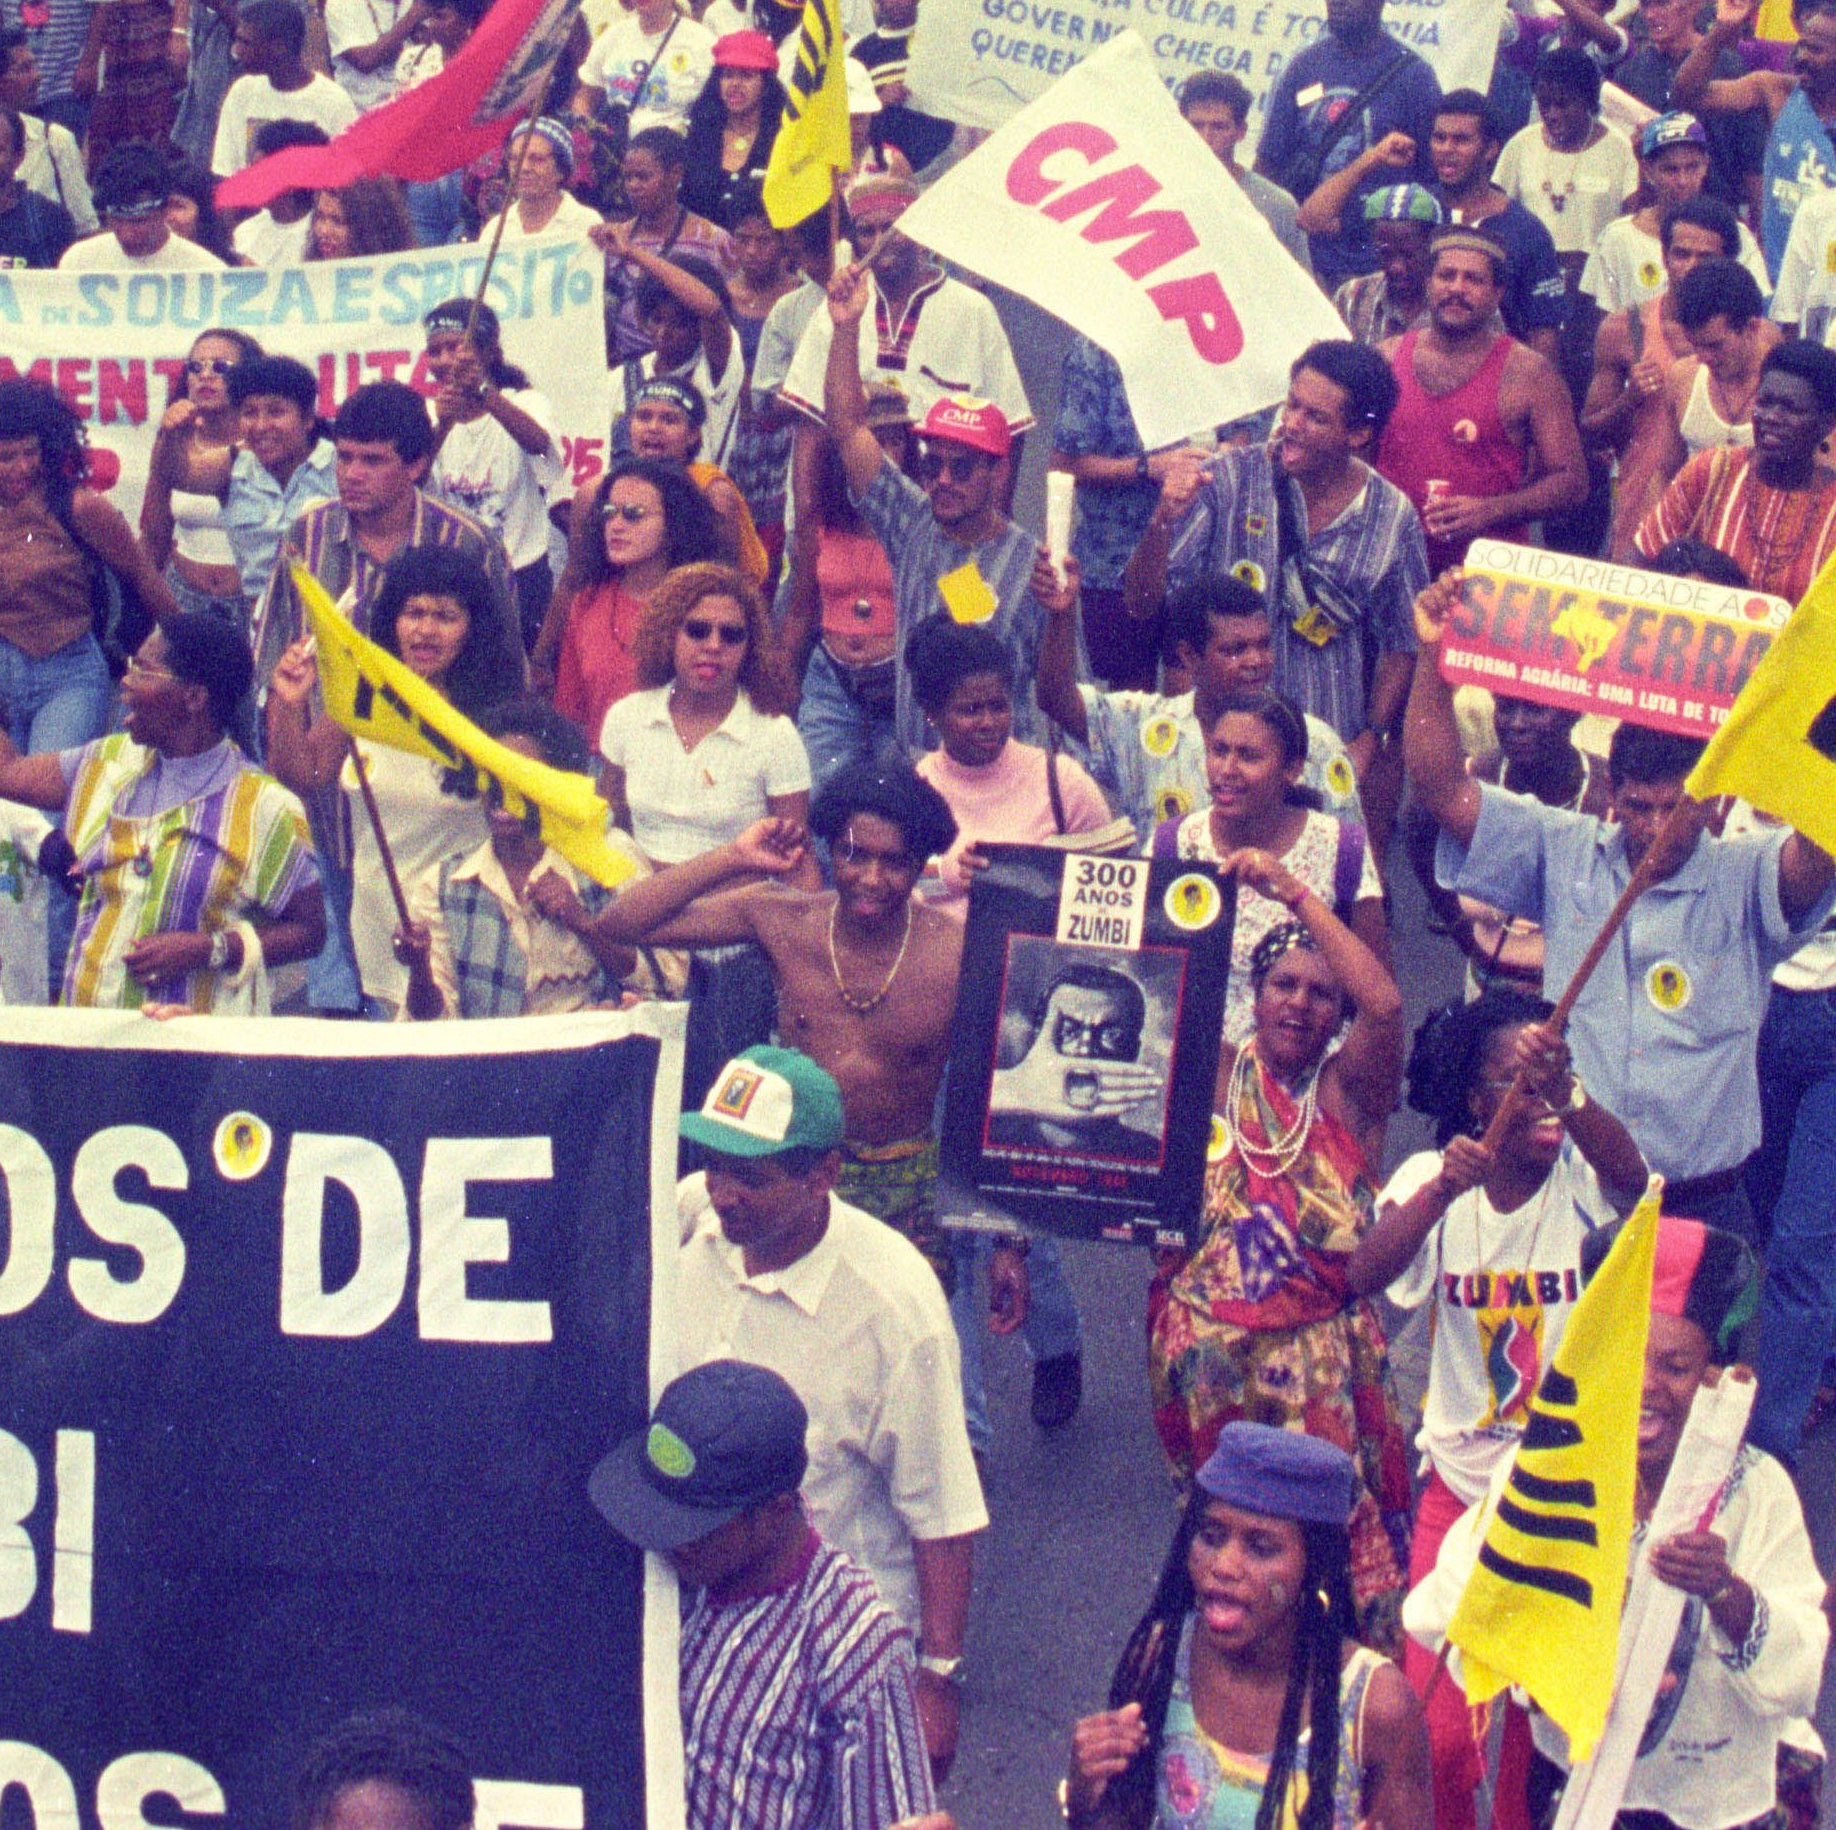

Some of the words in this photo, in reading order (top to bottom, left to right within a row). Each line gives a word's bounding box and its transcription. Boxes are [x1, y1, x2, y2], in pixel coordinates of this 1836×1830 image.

[1252, 2, 1274, 35] É
[1153, 33, 1253, 74] CHEGA
[1006, 121, 1246, 367] CMP
[78, 269, 320, 329] SOUZA
[942, 405, 981, 427] CMP
[1467, 541, 1713, 612] SOLIDARIEDADE
[1453, 573, 1576, 658] SEM
[1594, 600, 1779, 695] TERRA
[1445, 647, 1518, 681] REFORMA
[1521, 661, 1593, 697] AGRÁRIA:
[1598, 682, 1635, 708] UMA
[1638, 688, 1678, 717] LUTA
[1683, 699, 1705, 722] DE
[1075, 861, 1137, 889] 300
[1073, 888, 1135, 908] ANOS
[1066, 912, 1132, 945] ZUMBI
[276, 1130, 553, 1344] DE
[1443, 1268, 1578, 1310] ZUMBI
